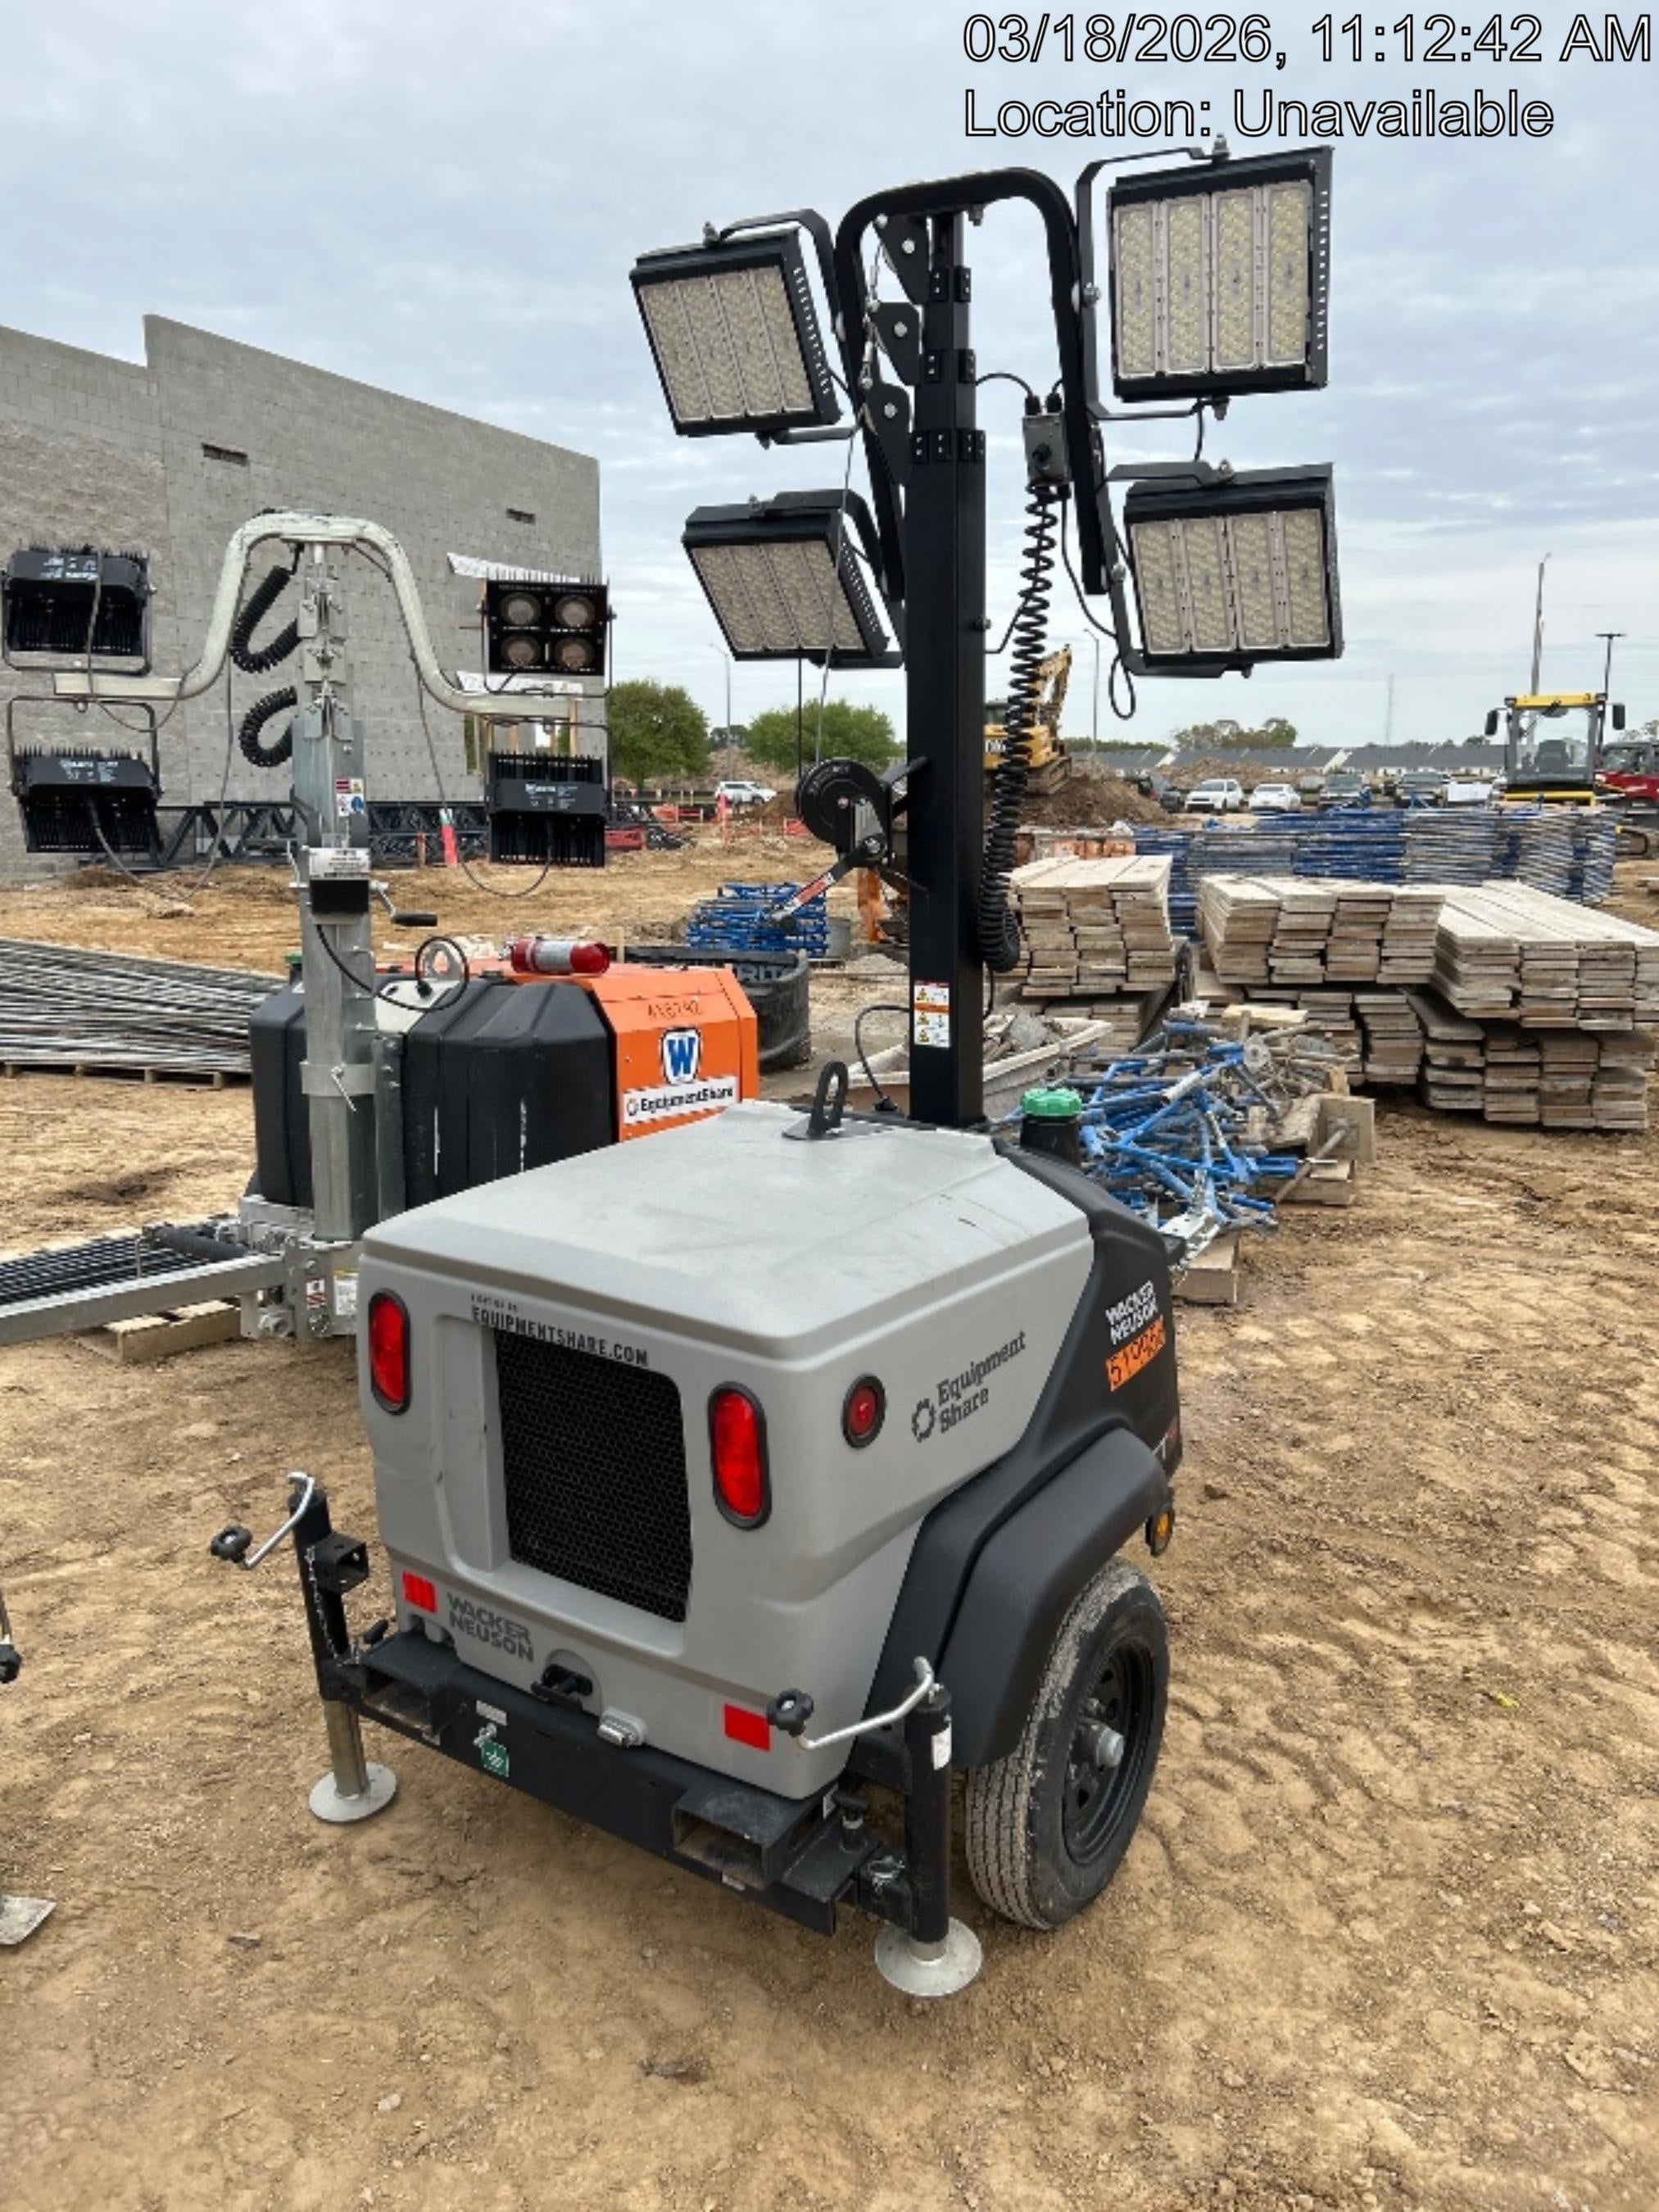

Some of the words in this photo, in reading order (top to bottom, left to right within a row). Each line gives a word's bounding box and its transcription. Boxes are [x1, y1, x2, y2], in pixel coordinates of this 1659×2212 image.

[668, 1036, 696, 1077] W
[471, 1304, 649, 1367] EQUIPMENTSHARE.COM
[936, 1330, 1026, 1407] Equipment
[939, 1387, 990, 1435] Share
[446, 1592, 532, 1646] WACKER
[449, 1611, 534, 1664] NEUSON
